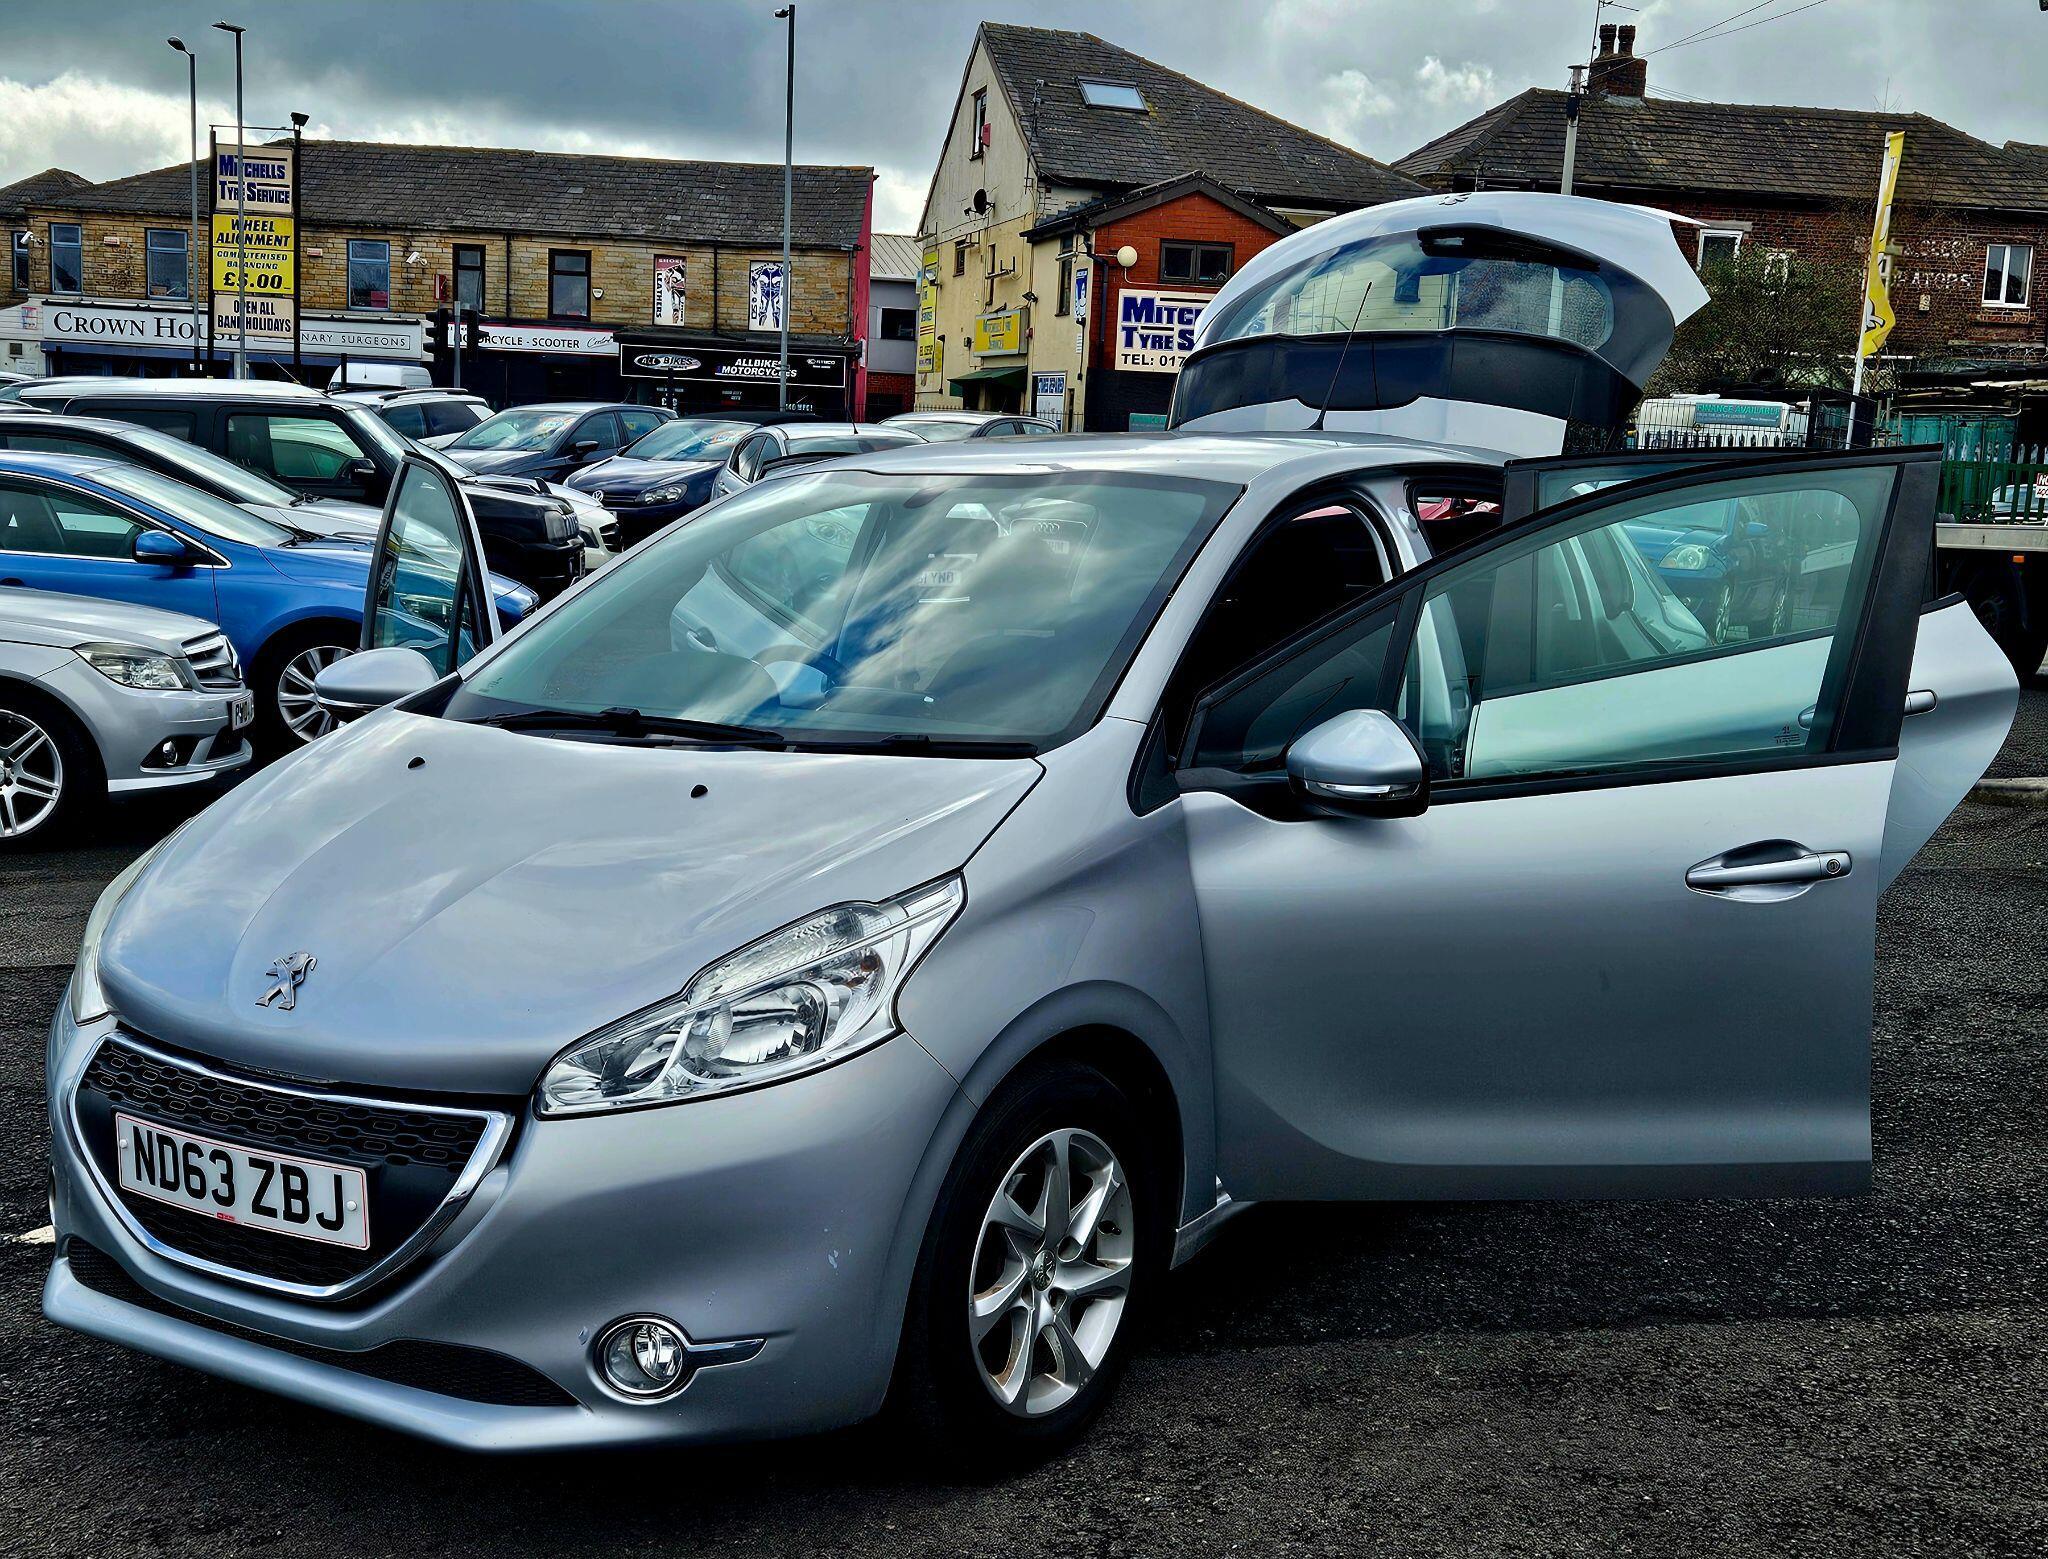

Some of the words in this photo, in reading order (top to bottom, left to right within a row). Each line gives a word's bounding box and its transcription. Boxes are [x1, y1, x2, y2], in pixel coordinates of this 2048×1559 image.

[219, 154, 286, 180] MITCHELLS
[219, 180, 246, 202] TYRE
[246, 182, 291, 205] SERVICE
[231, 218, 275, 233] WHEEL
[217, 250, 288, 261] COMUTERISED
[226, 260, 279, 270] BAANCING
[655, 272, 663, 319] LEATHERS
[233, 299, 258, 315] OEN
[259, 301, 276, 316] ALL
[53, 311, 146, 337] CROWN
[217, 314, 242, 329] BAN
[245, 316, 292, 333] HOLIDAYS
[340, 335, 407, 348] SURGEONS
[531, 337, 580, 349] SCOOTER
[1121, 326, 1174, 351] TYRE
[641, 356, 657, 366] ALL
[662, 356, 694, 367] BIKES
[1121, 353, 1154, 366] TEL:
[722, 366, 797, 378] MOTORCYCES
[1697, 404, 1733, 413] FINANCE
[132, 1126, 236, 1207] ND63
[248, 1157, 344, 1231] ZBJ
